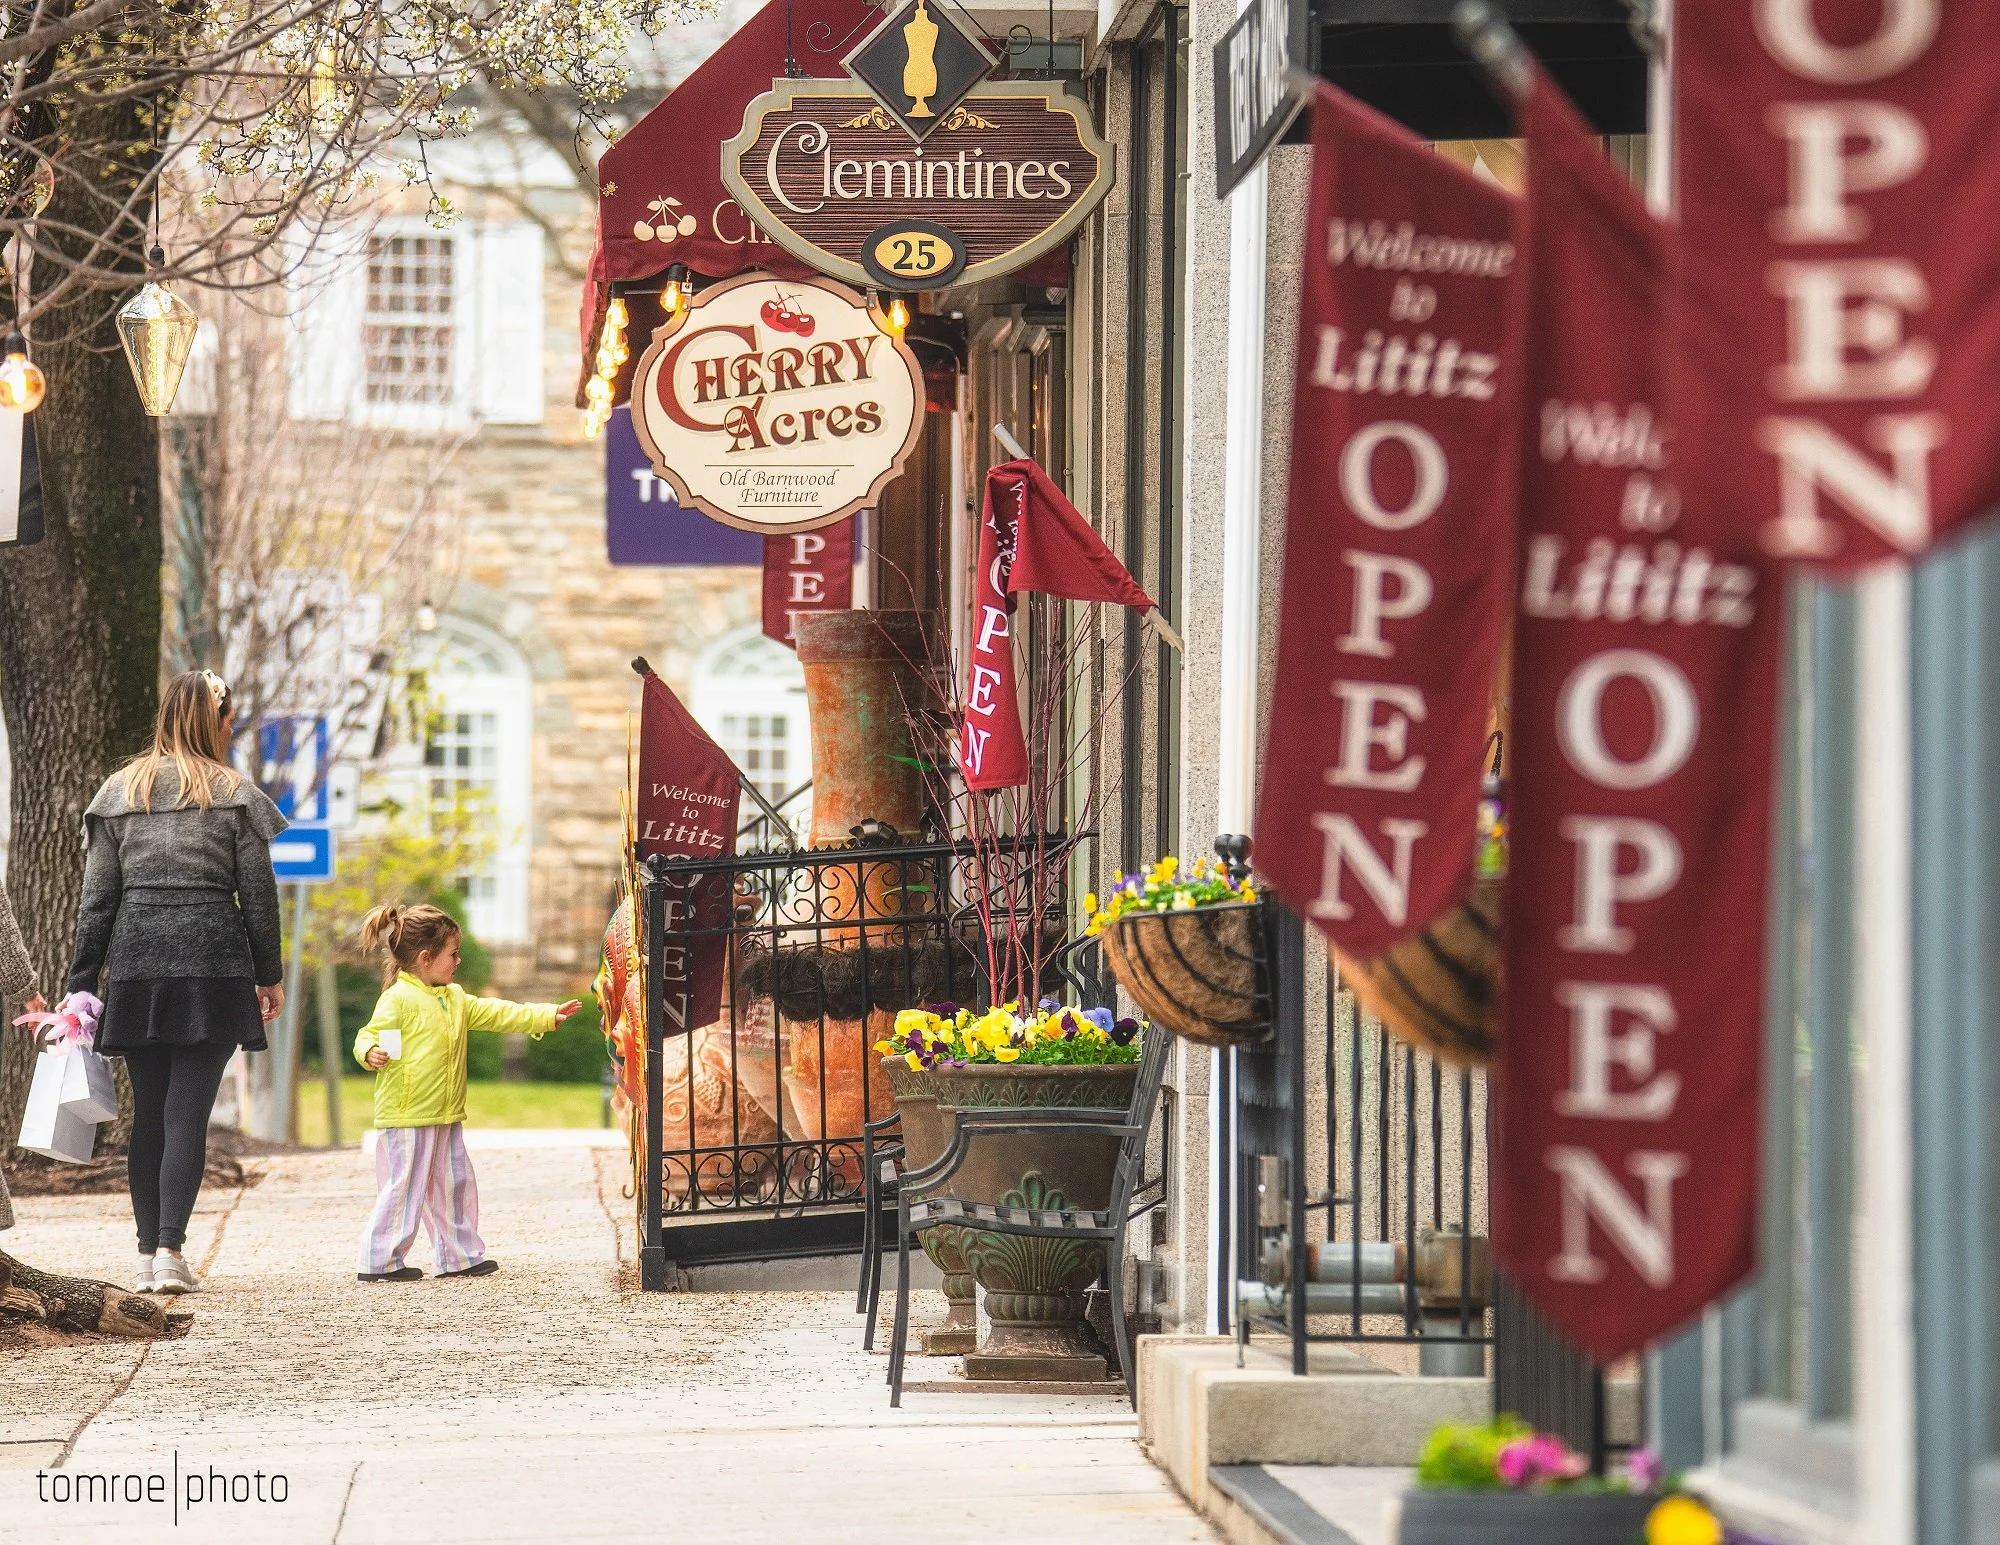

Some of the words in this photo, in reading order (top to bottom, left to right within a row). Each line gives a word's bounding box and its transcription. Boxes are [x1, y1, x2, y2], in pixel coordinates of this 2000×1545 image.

[766, 120, 1073, 214] Clemintines
[892, 239, 936, 270] 25
[1327, 216, 1516, 278] Welcome
[1390, 276, 1437, 323] to
[656, 323, 882, 433] CHERRY
[1310, 324, 1500, 400] Lititz
[724, 396, 883, 454] Acres
[719, 469, 752, 487] Old
[752, 469, 840, 487] Barnwood
[740, 487, 819, 504] Furniture
[784, 532, 826, 640] PE
[1523, 534, 1757, 628] Lititz
[1306, 420, 1449, 927] OPEN
[652, 783, 731, 808] Welcome
[681, 805, 699, 819] to
[641, 820, 724, 849] Lititz
[1543, 647, 1700, 1289] OPEN
